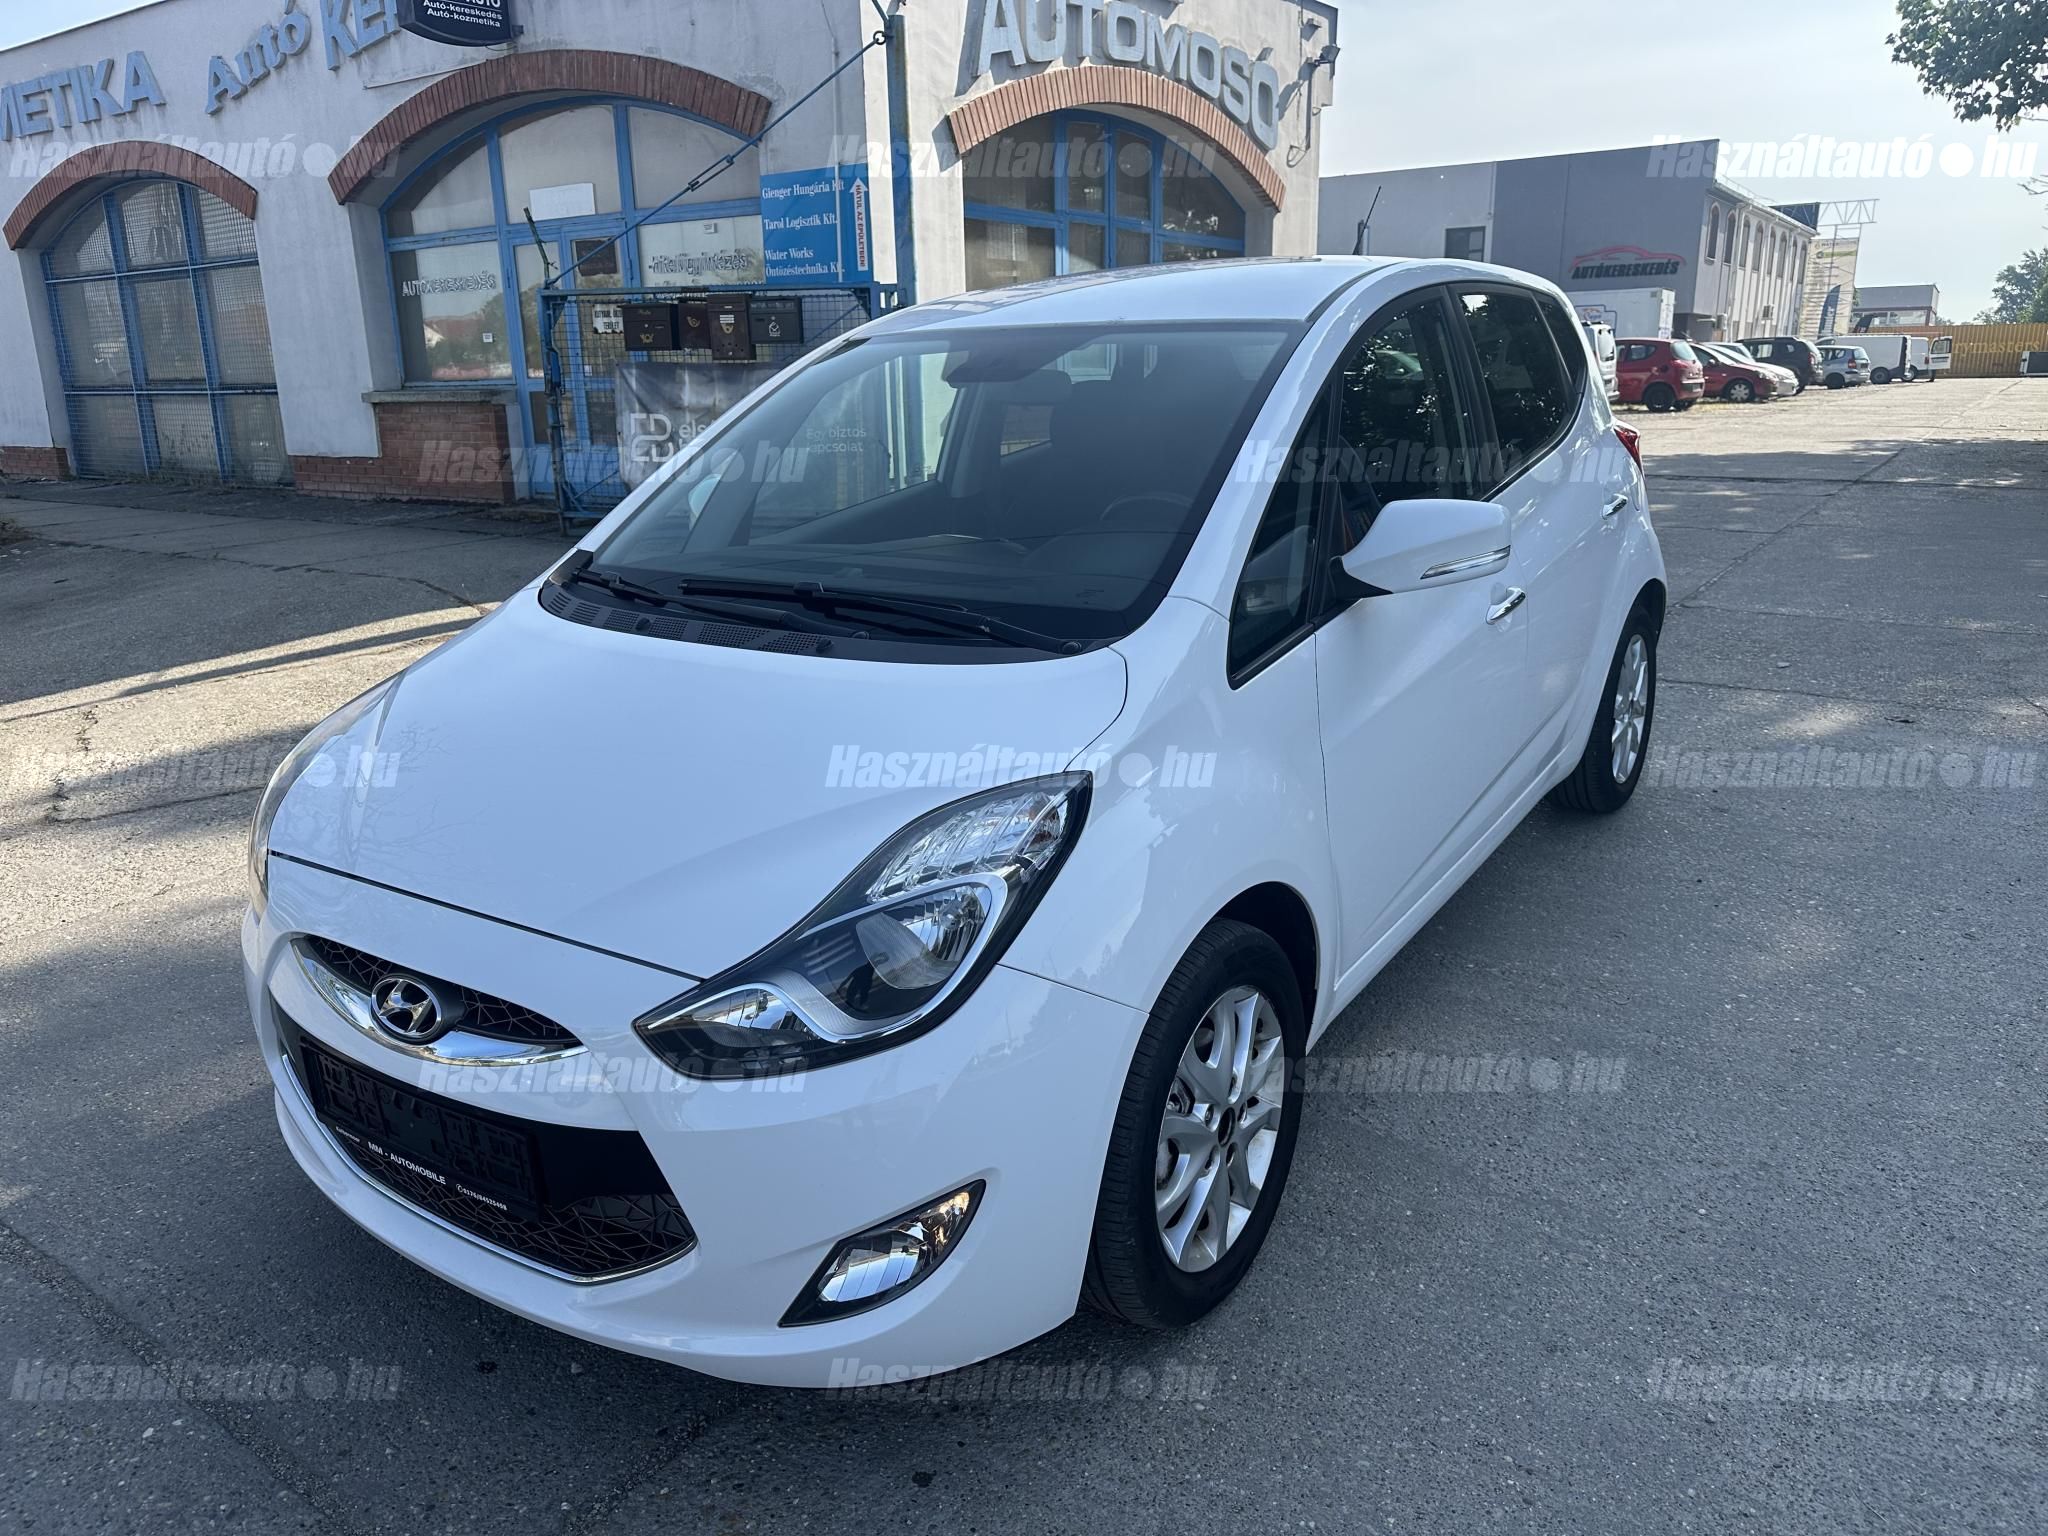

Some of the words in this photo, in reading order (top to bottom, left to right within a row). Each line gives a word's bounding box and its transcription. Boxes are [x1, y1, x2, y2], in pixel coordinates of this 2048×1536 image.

[427, 8, 501, 27] Autó-kozmetika
[976, 0, 1280, 150] AUTOMOSÓ
[762, 185, 791, 200] Gienger
[793, 181, 830, 197] Hungária
[786, 214, 821, 230] Logisztik
[765, 250, 787, 260] Water
[789, 247, 814, 258] Works
[1571, 258, 1680, 280] AUTÓKERESKEDÉS
[368, 1141, 384, 1156] MM
[390, 1153, 446, 1185] AUTOMOBILE
